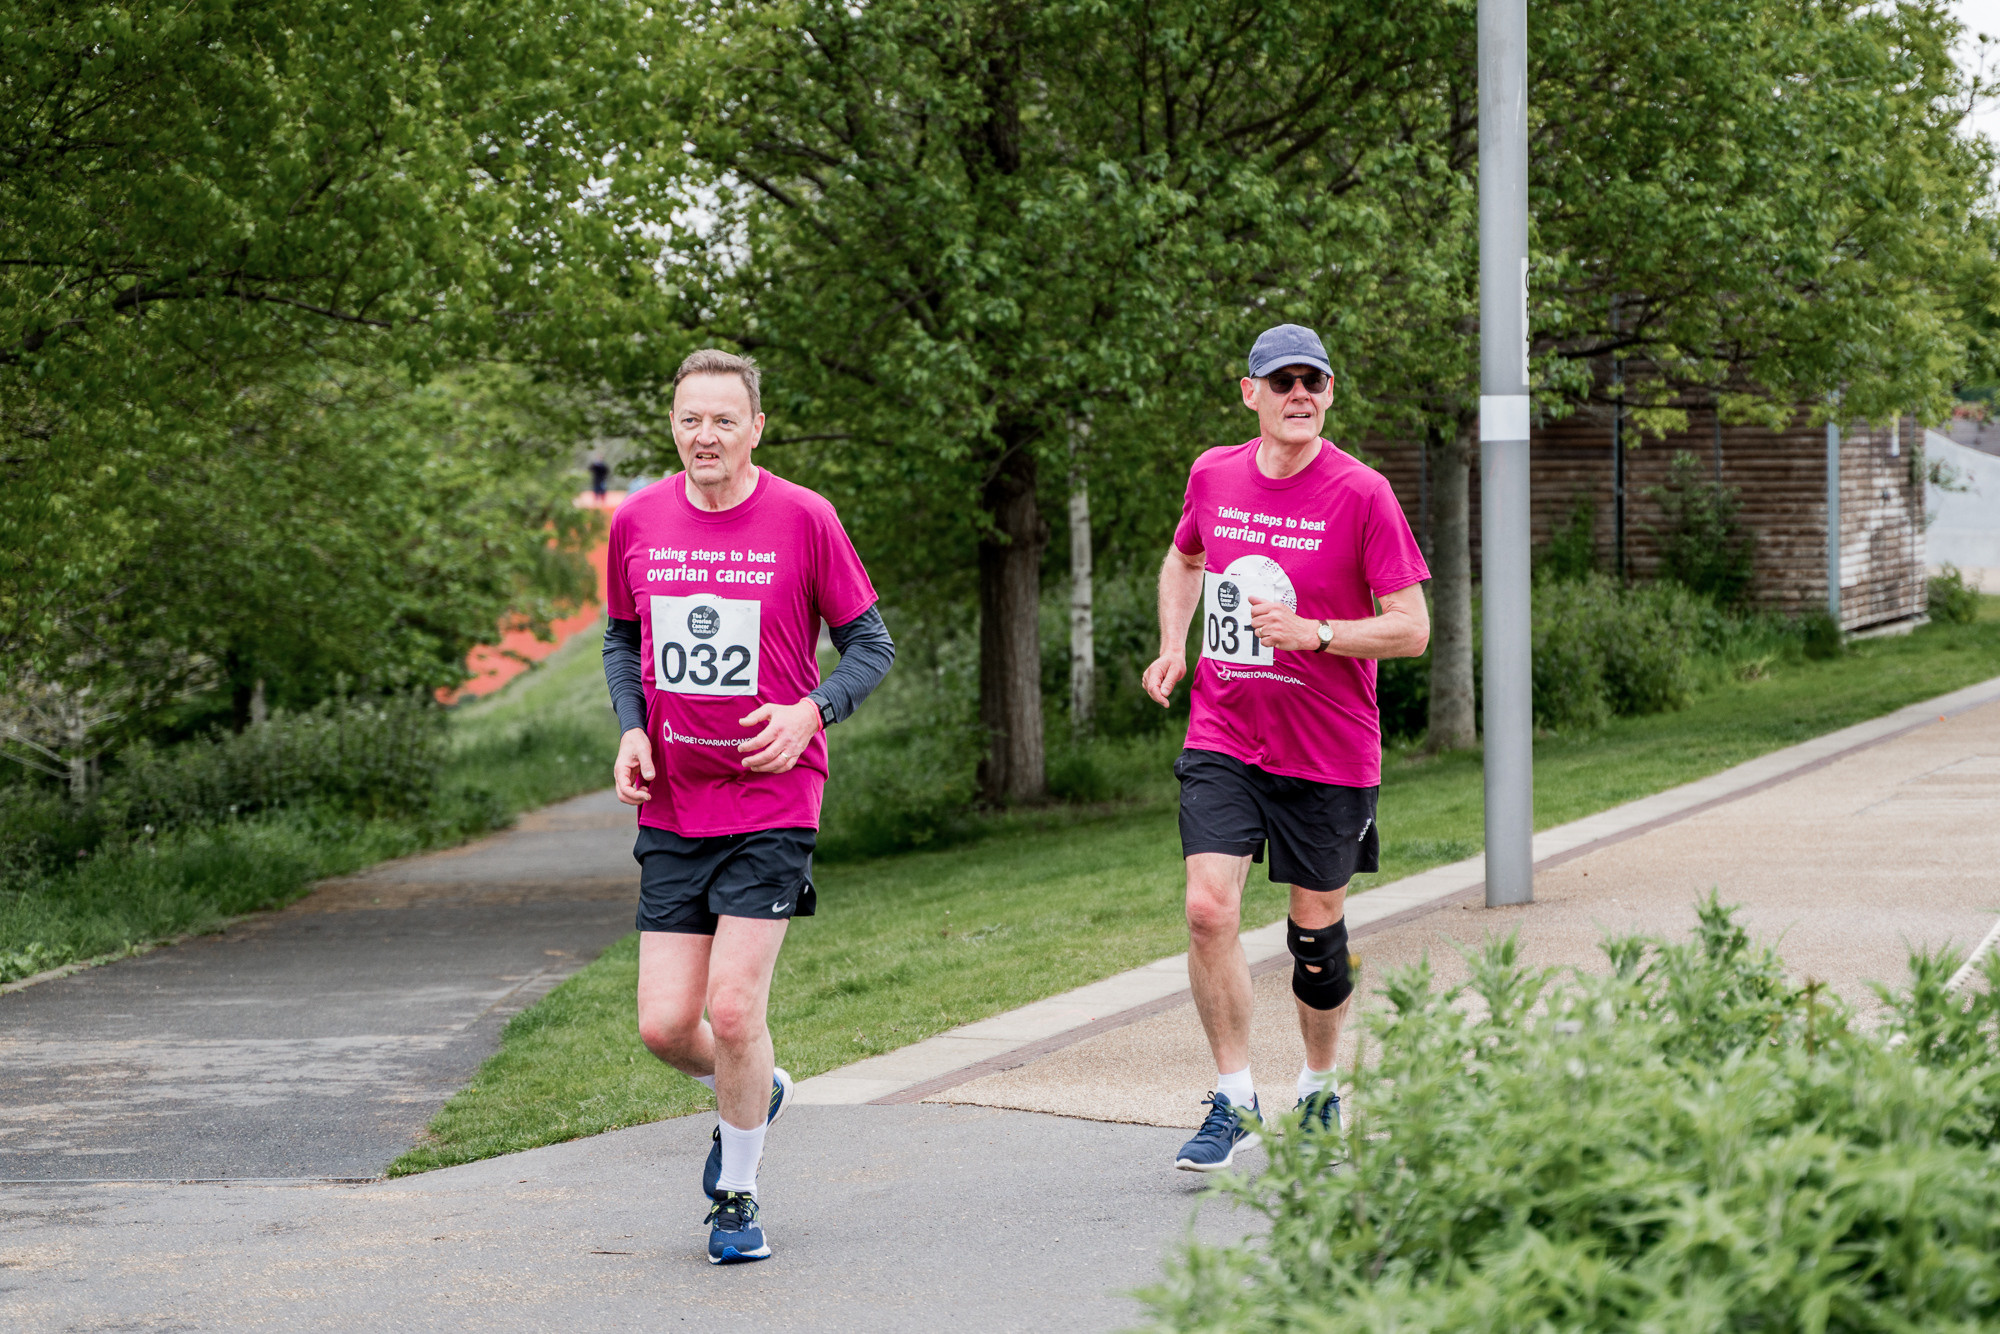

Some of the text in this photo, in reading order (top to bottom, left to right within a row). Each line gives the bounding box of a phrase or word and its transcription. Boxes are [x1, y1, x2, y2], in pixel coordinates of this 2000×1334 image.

[1217, 506, 1326, 532] Taking steps to beat
[1213, 525, 1323, 551] ovarian cancer
[648, 547, 776, 564] Taking steps to beat
[646, 563, 775, 585] ovarian cancer
[1208, 613, 1260, 657] 031
[662, 641, 751, 686] 032
[1231, 671, 1306, 686] TARGET OVARIAN CAN
[672, 732, 755, 747] TARGET OVARIAN CAN
